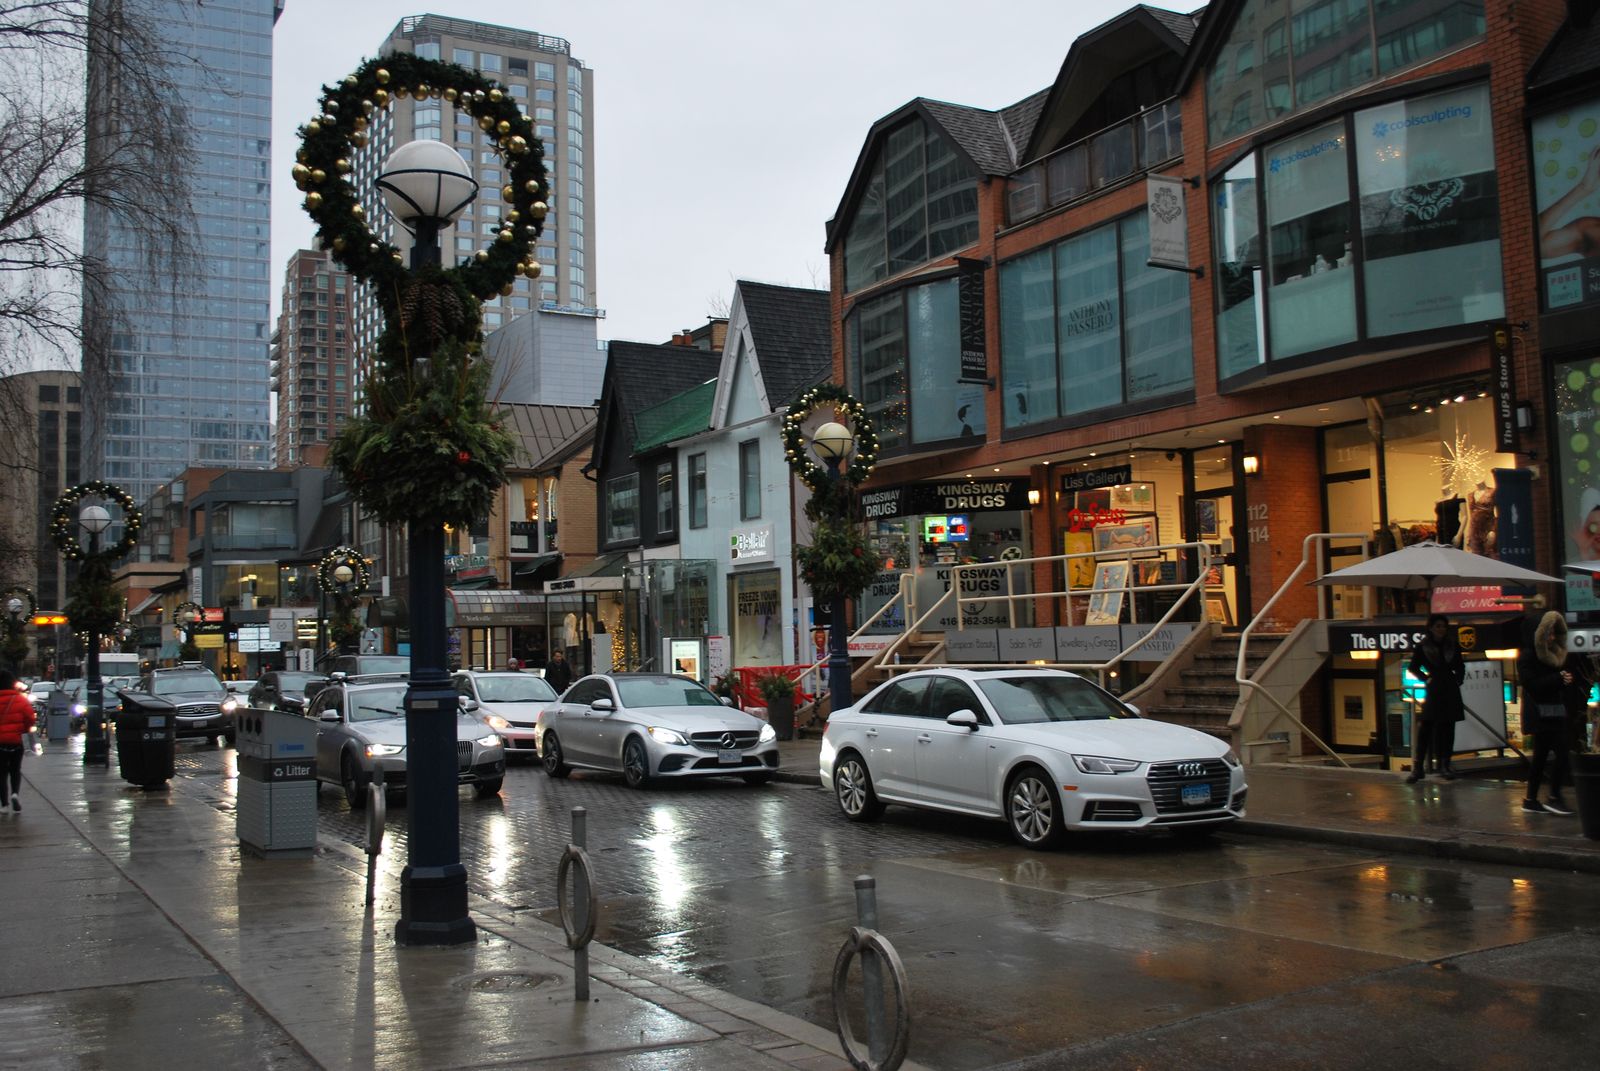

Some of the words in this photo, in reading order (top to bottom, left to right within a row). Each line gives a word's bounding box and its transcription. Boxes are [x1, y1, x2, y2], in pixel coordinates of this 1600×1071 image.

[1389, 105, 1472, 131] coolsculpting
[1280, 137, 1339, 166] coolsculpting
[960, 274, 973, 343] ANTHONY
[972, 272, 984, 346] PASSERO
[1068, 299, 1112, 323] ANTHONY
[1067, 312, 1113, 337] PASSERO
[1499, 355, 1509, 389] Store
[1501, 392, 1511, 418] UPS
[1503, 420, 1513, 445] The
[936, 482, 1013, 496] KINGSWAY
[1064, 477, 1083, 490] Liss
[1086, 471, 1128, 487] Gallery
[861, 489, 900, 505] KINGSWAY
[944, 494, 1006, 510] DRUGS
[865, 502, 897, 518] DRUGS
[1246, 503, 1269, 520] 112
[1247, 526, 1270, 543] 114
[936, 568, 1007, 580] KIGSWAY
[738, 592, 759, 602] FREEZE
[759, 590, 777, 600] YOUR
[1459, 598, 1478, 609] ON
[739, 603, 753, 616] FAT
[754, 600, 777, 616] AWAY
[1058, 637, 1088, 651] Jewellery
[1093, 636, 1118, 651] Gregg
[1350, 633, 1376, 649] The
[1379, 632, 1408, 650] UPS
[286, 765, 311, 777] Litter
